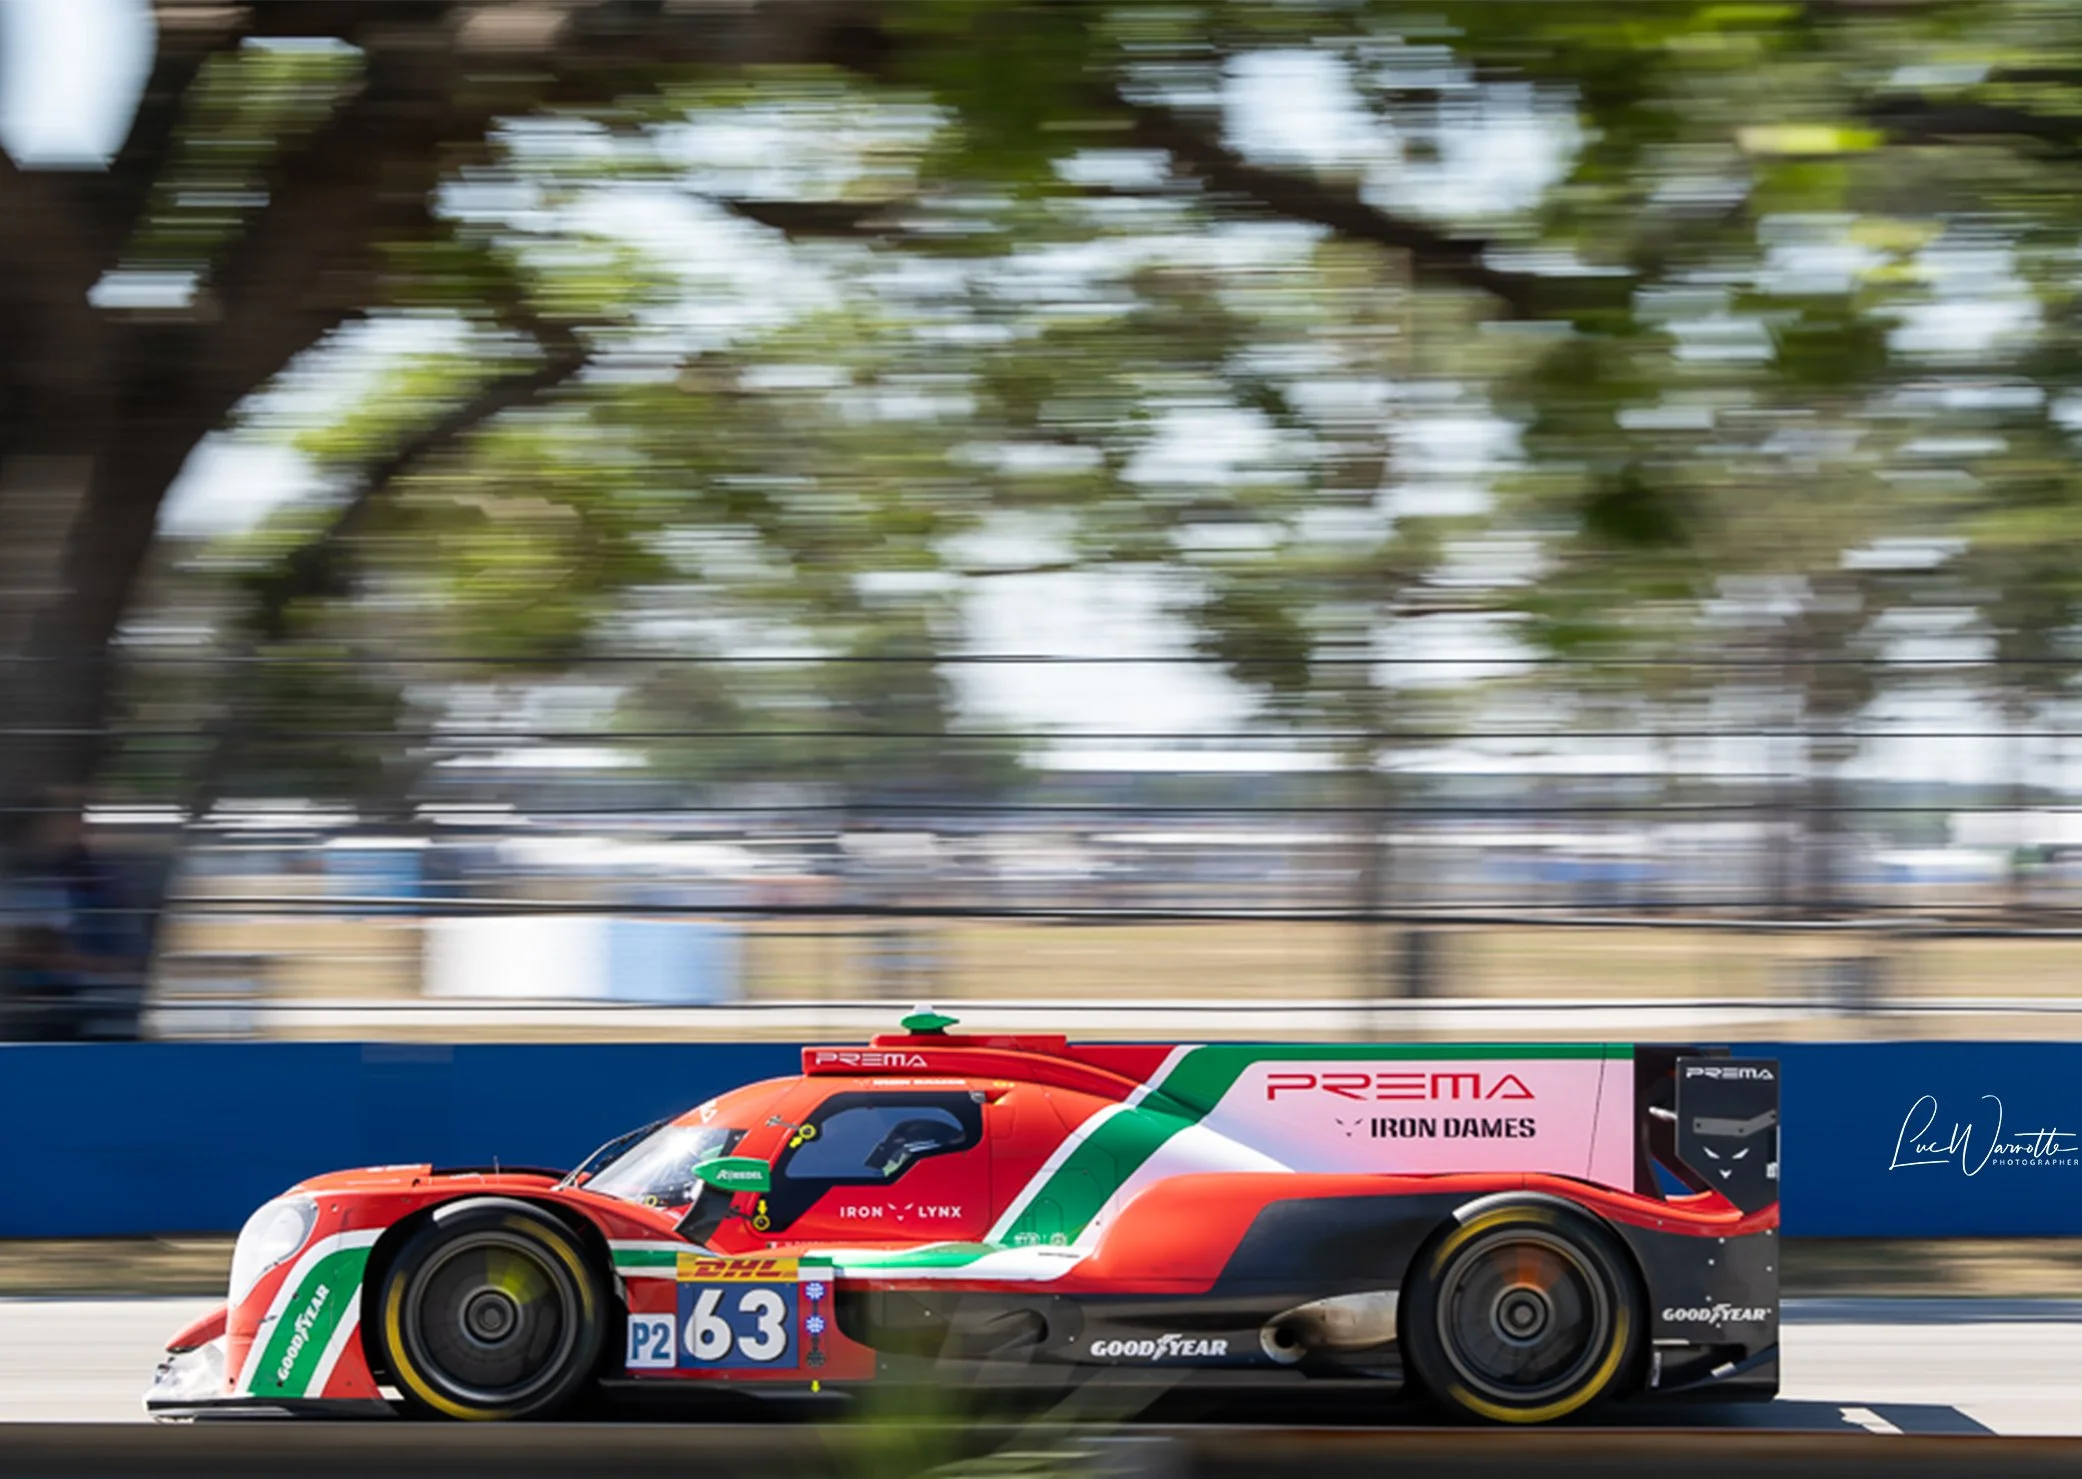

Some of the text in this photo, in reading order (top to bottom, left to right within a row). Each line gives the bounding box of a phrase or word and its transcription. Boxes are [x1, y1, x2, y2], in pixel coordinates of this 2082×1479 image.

[816, 1053, 928, 1067] PREMA
[1686, 1066, 1775, 1080] PREMA
[1267, 1073, 1535, 1101] PREMA
[1371, 1118, 1536, 1138] IRON DAMES
[840, 1206, 962, 1218] IRON LYNX
[694, 1260, 783, 1278] DHL
[683, 1288, 788, 1361] 63
[1662, 1303, 1768, 1325] GOODYEAR
[277, 1284, 330, 1381] GOODYEAR
[631, 1322, 671, 1360] P2
[1090, 1333, 1229, 1361] GOODYEAR
